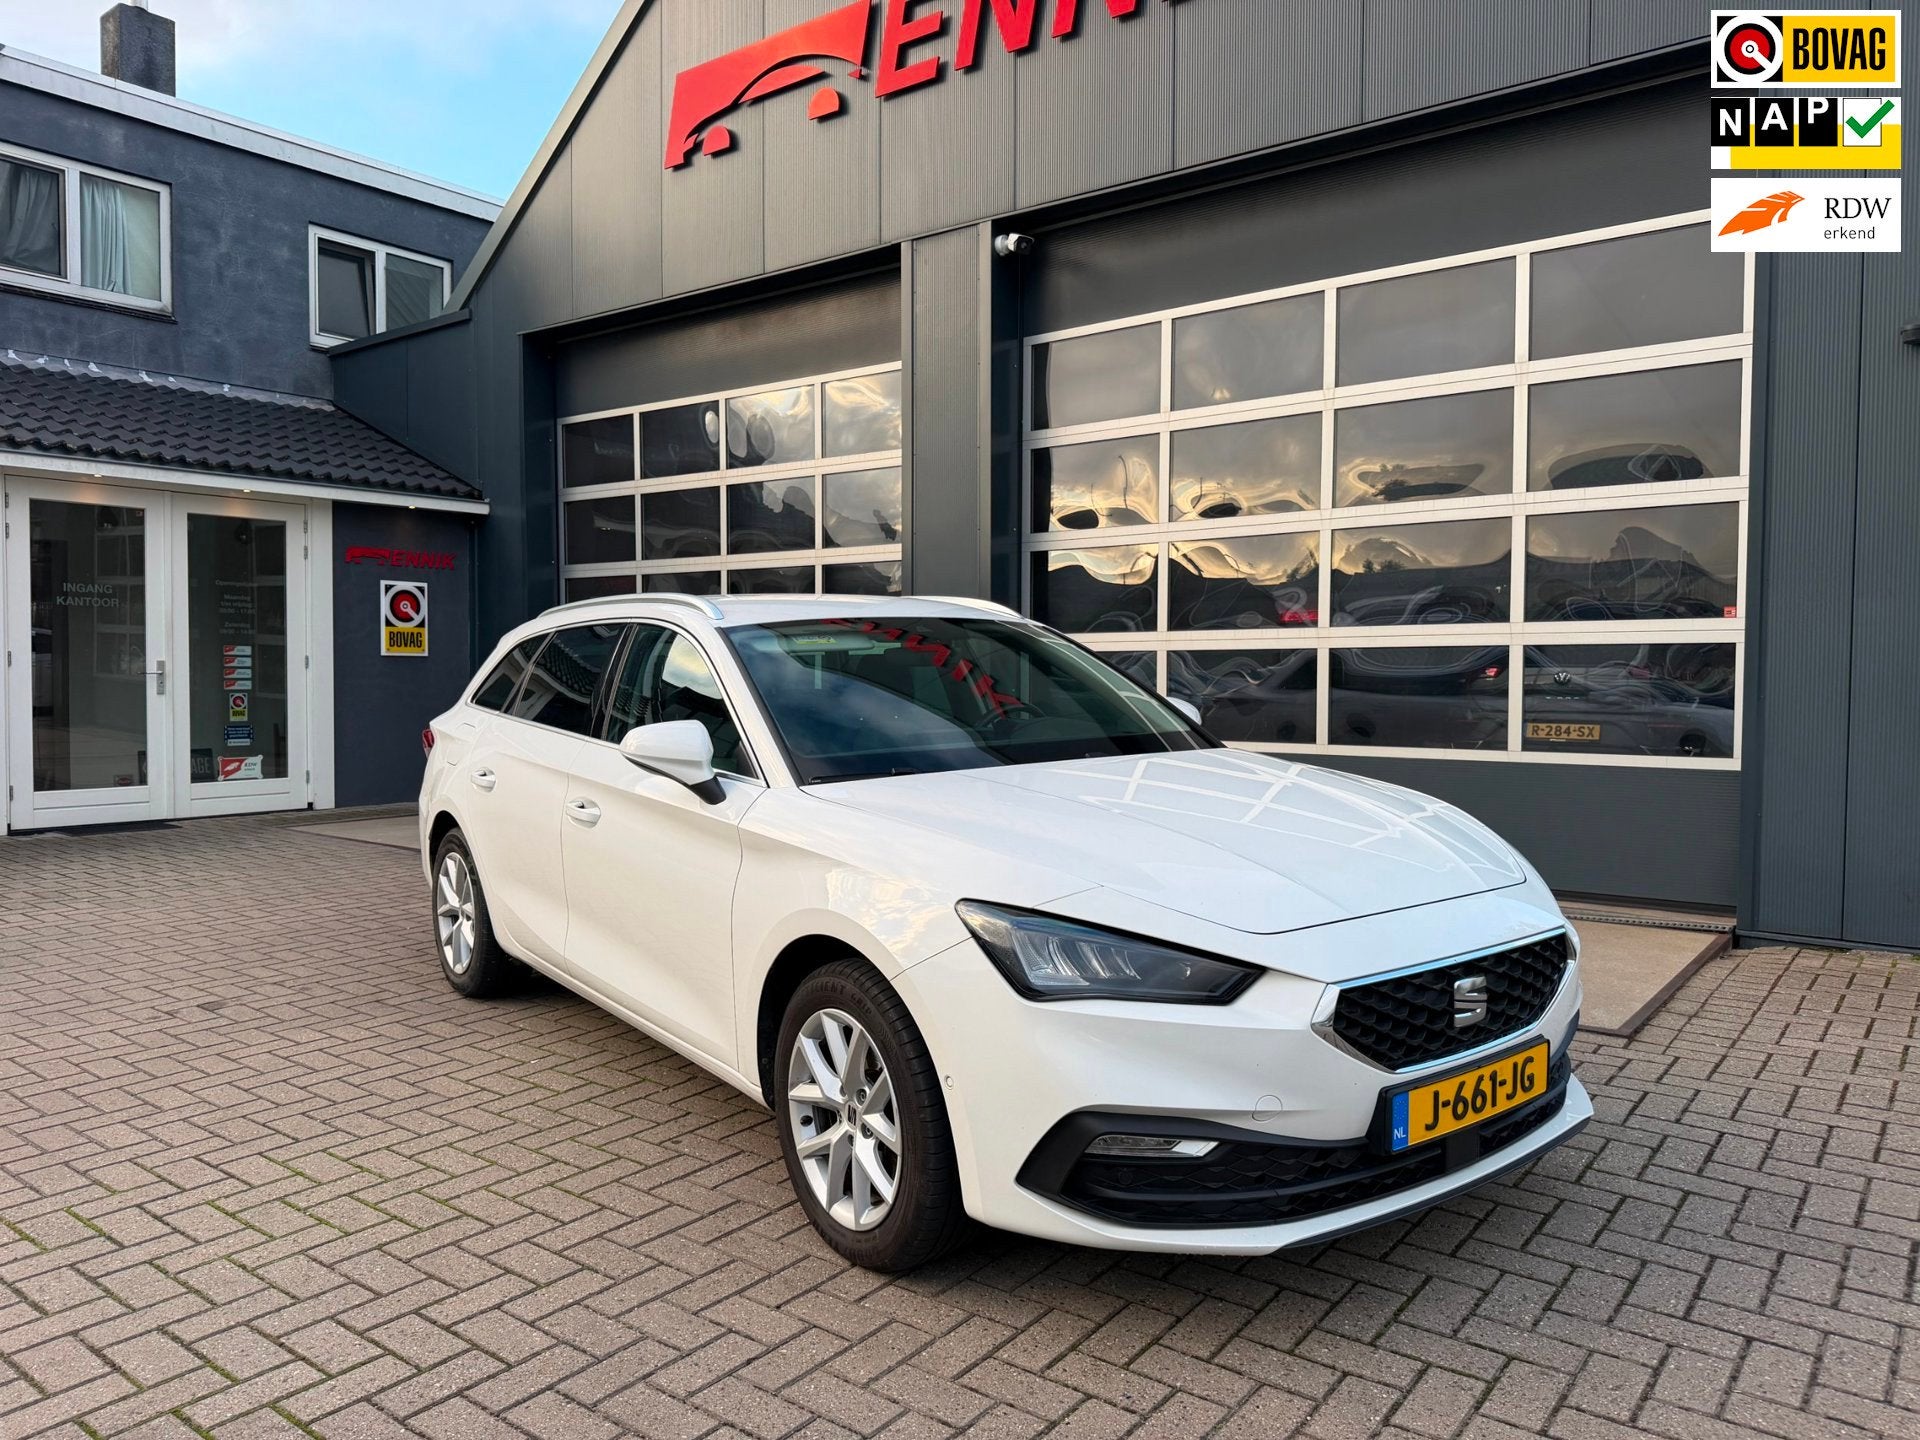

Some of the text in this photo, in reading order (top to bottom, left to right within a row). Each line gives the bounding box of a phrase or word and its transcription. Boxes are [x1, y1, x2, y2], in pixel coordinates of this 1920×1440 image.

[63, 582, 113, 594] INGANG
[56, 596, 119, 608] KANTOOR
[388, 631, 423, 649] BOVAG
[1531, 724, 1596, 738] R-284-SX
[1424, 1055, 1535, 1132] J-661-JG
[1393, 1127, 1407, 1140] NL
